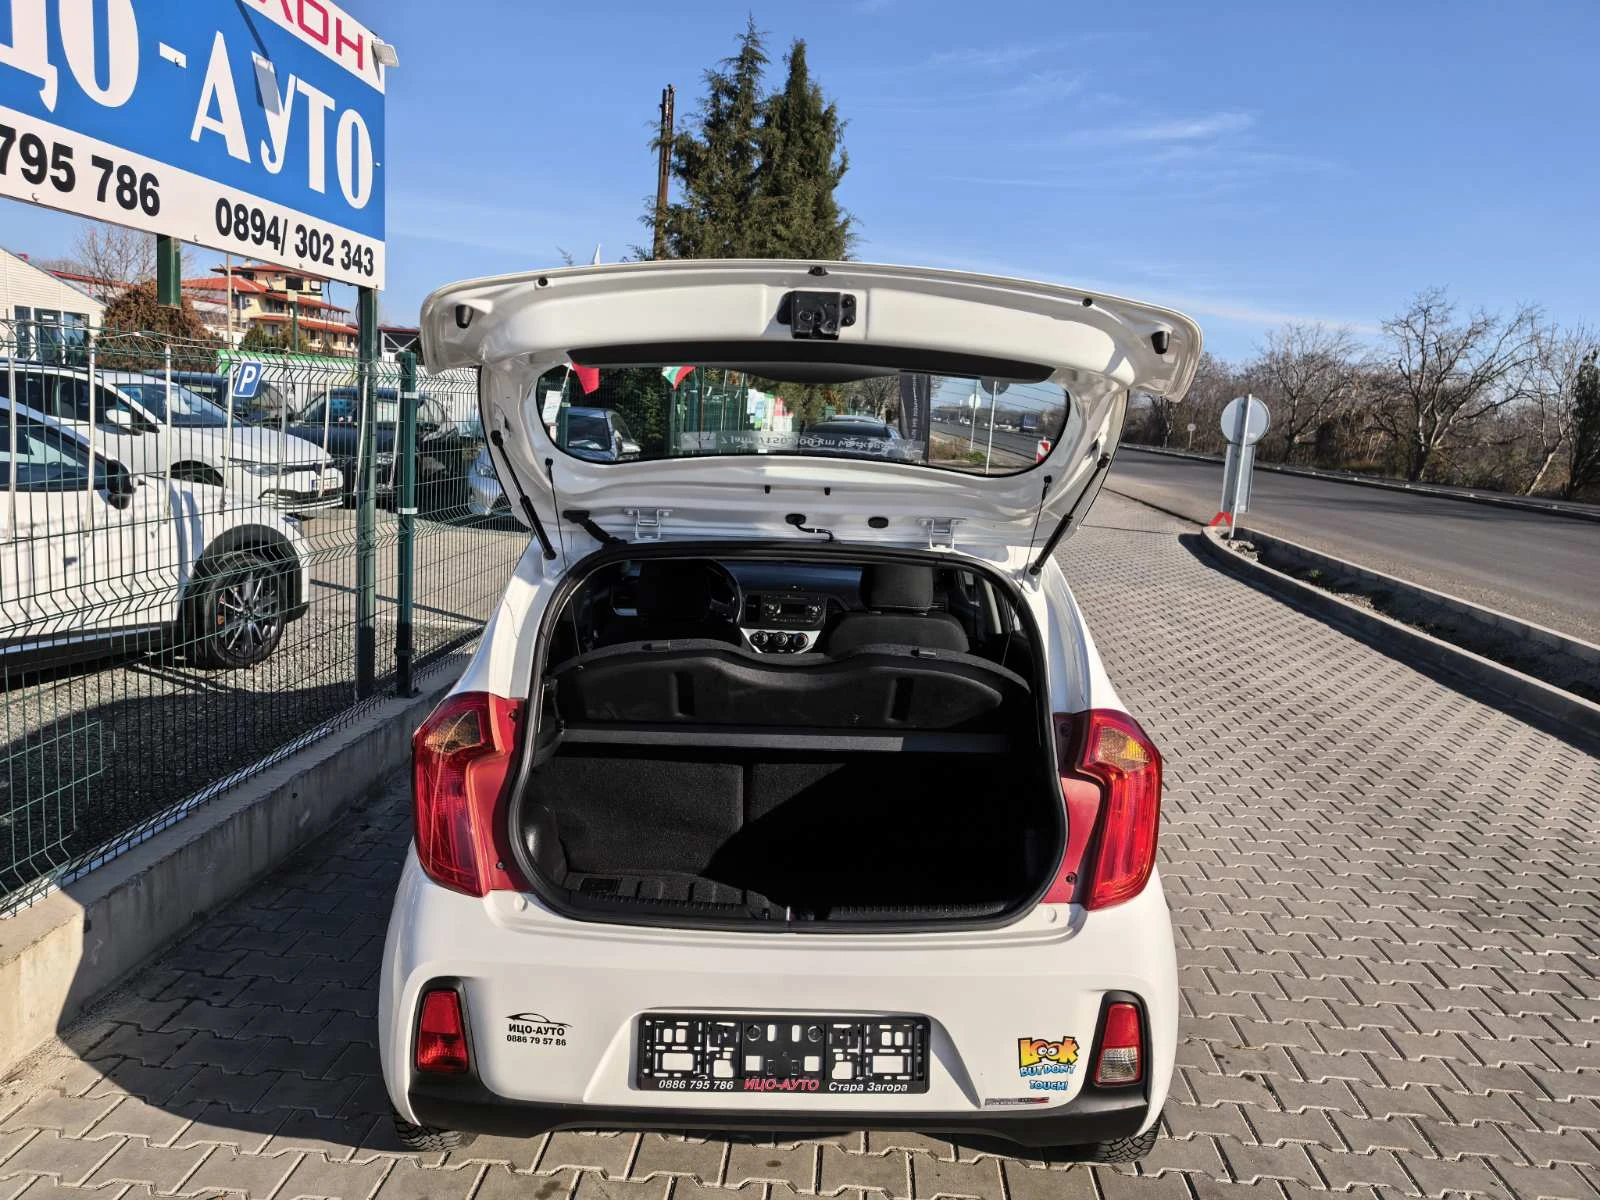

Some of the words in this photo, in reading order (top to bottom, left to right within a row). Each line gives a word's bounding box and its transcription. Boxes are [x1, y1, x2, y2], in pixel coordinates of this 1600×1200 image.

[0, 124, 76, 193] 795
[91, 154, 160, 216] 786
[215, 197, 288, 256] 0894/
[294, 223, 334, 266] 302
[340, 239, 374, 277] 343
[239, 365, 257, 392] P
[508, 1023, 565, 1036] ИЦО-АУТО
[506, 1034, 528, 1043] 0886
[530, 1036, 541, 1044] 79
[542, 1037, 553, 1045] 57
[555, 1038, 567, 1046] 86
[1020, 1065, 1043, 1077] BUT
[658, 1080, 687, 1089] 0886
[689, 1080, 711, 1090] 795
[713, 1081, 735, 1090] 786
[743, 1078, 820, 1092] ИЦО-АУТО
[828, 1081, 864, 1093] Стара
[866, 1082, 909, 1093] Загора
